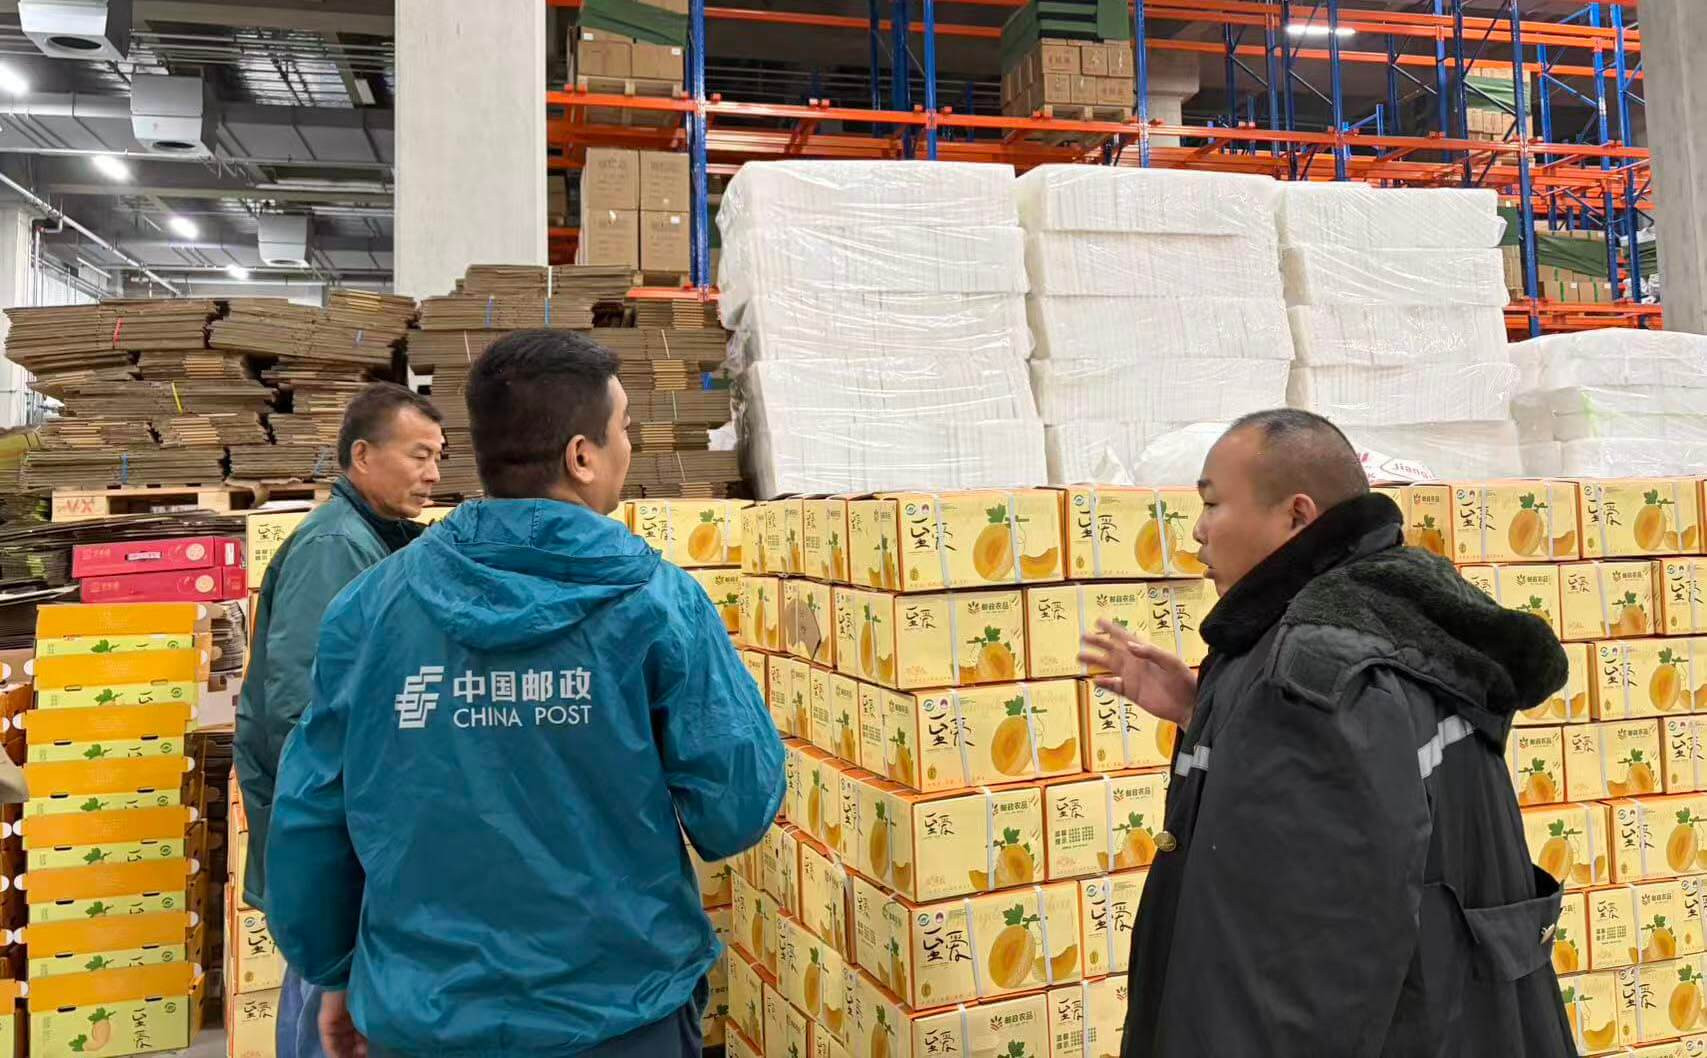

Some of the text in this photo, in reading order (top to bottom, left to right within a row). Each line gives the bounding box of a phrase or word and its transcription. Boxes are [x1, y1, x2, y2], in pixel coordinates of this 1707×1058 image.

[906, 606, 936, 629] 至爱
[453, 667, 591, 703] 中国邮政
[453, 705, 592, 728] CHINA POST
[925, 812, 955, 836] 至爱
[923, 927, 973, 962] 至爱
[925, 1029, 957, 1054] 至爱
